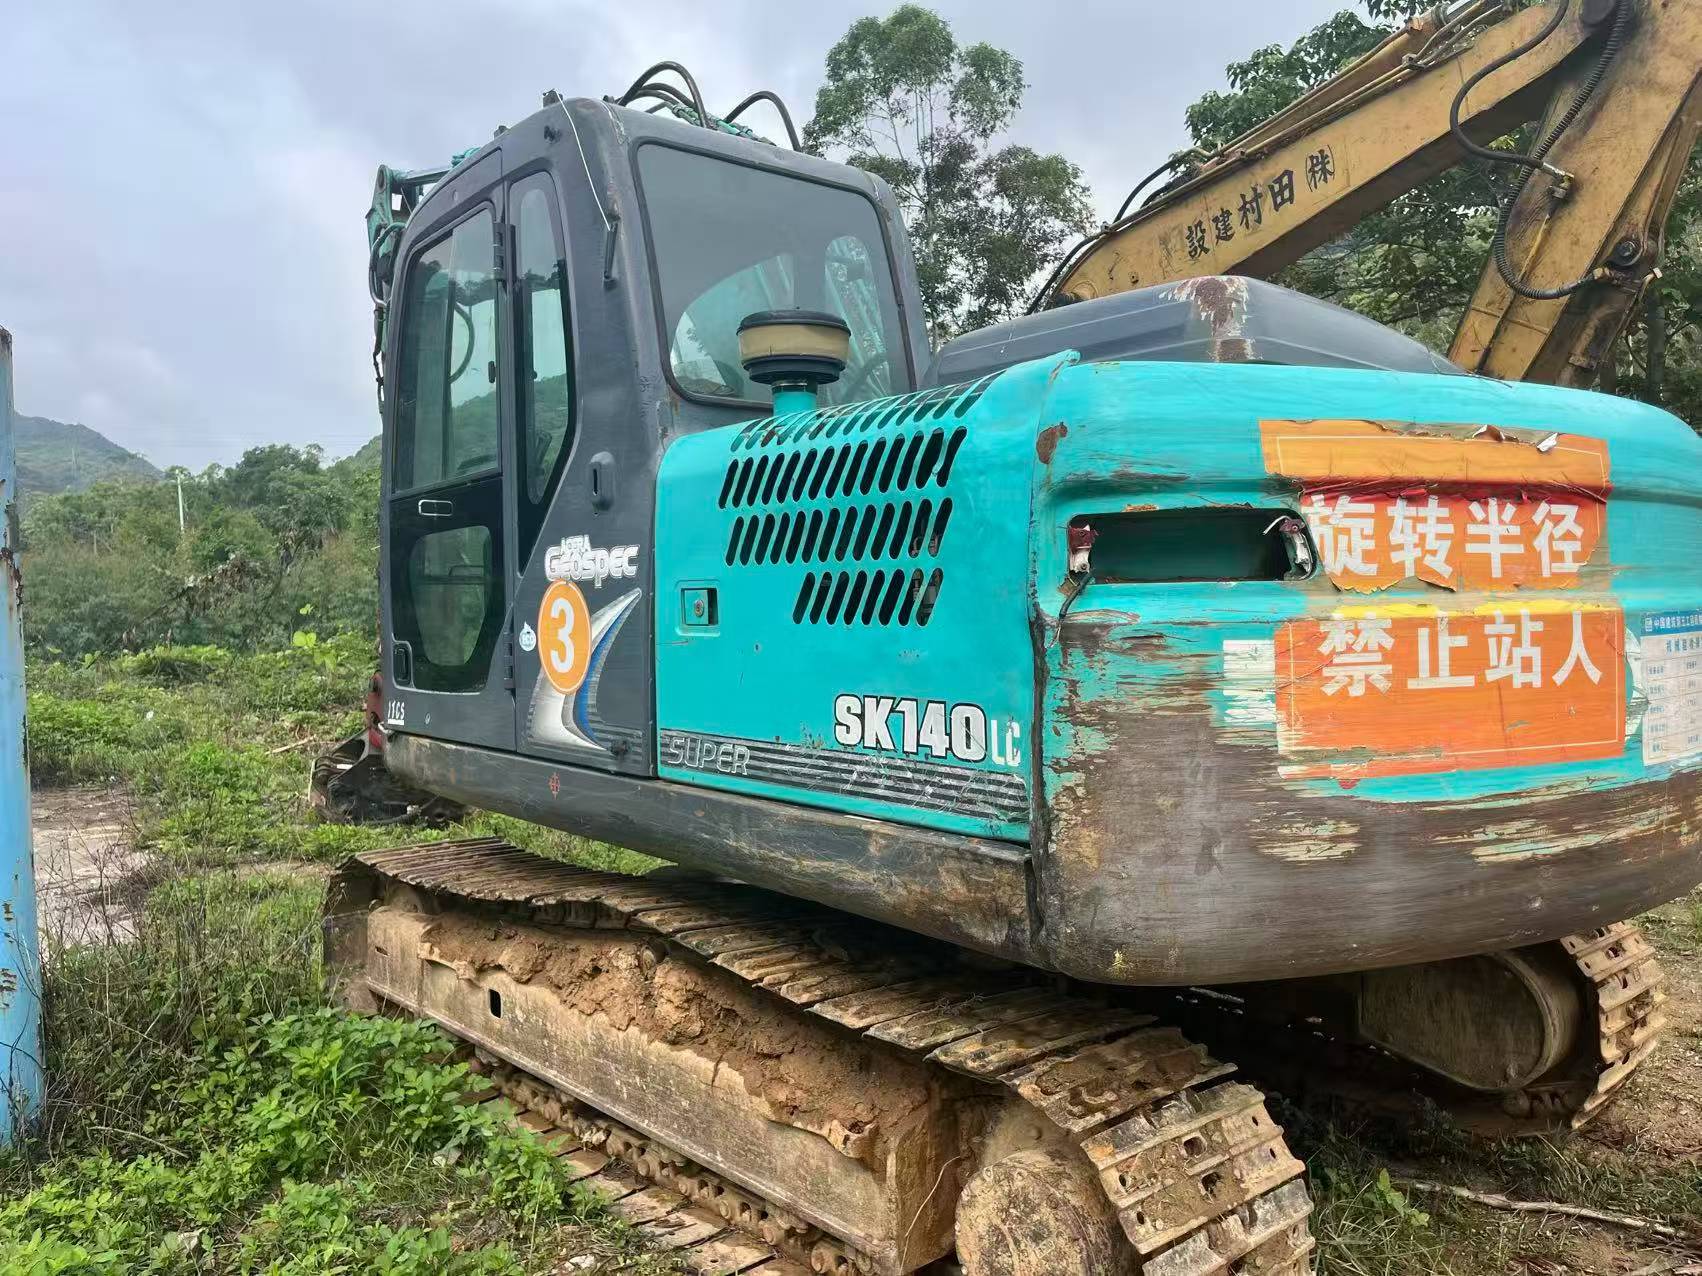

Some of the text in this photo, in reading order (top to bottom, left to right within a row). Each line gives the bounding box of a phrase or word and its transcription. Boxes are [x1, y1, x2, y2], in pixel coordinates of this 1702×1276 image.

[1303, 494, 1584, 579] 旋转半径
[550, 597, 575, 673] 3
[1318, 610, 1602, 697] 禁止站人
[667, 736, 750, 776] SUPER
